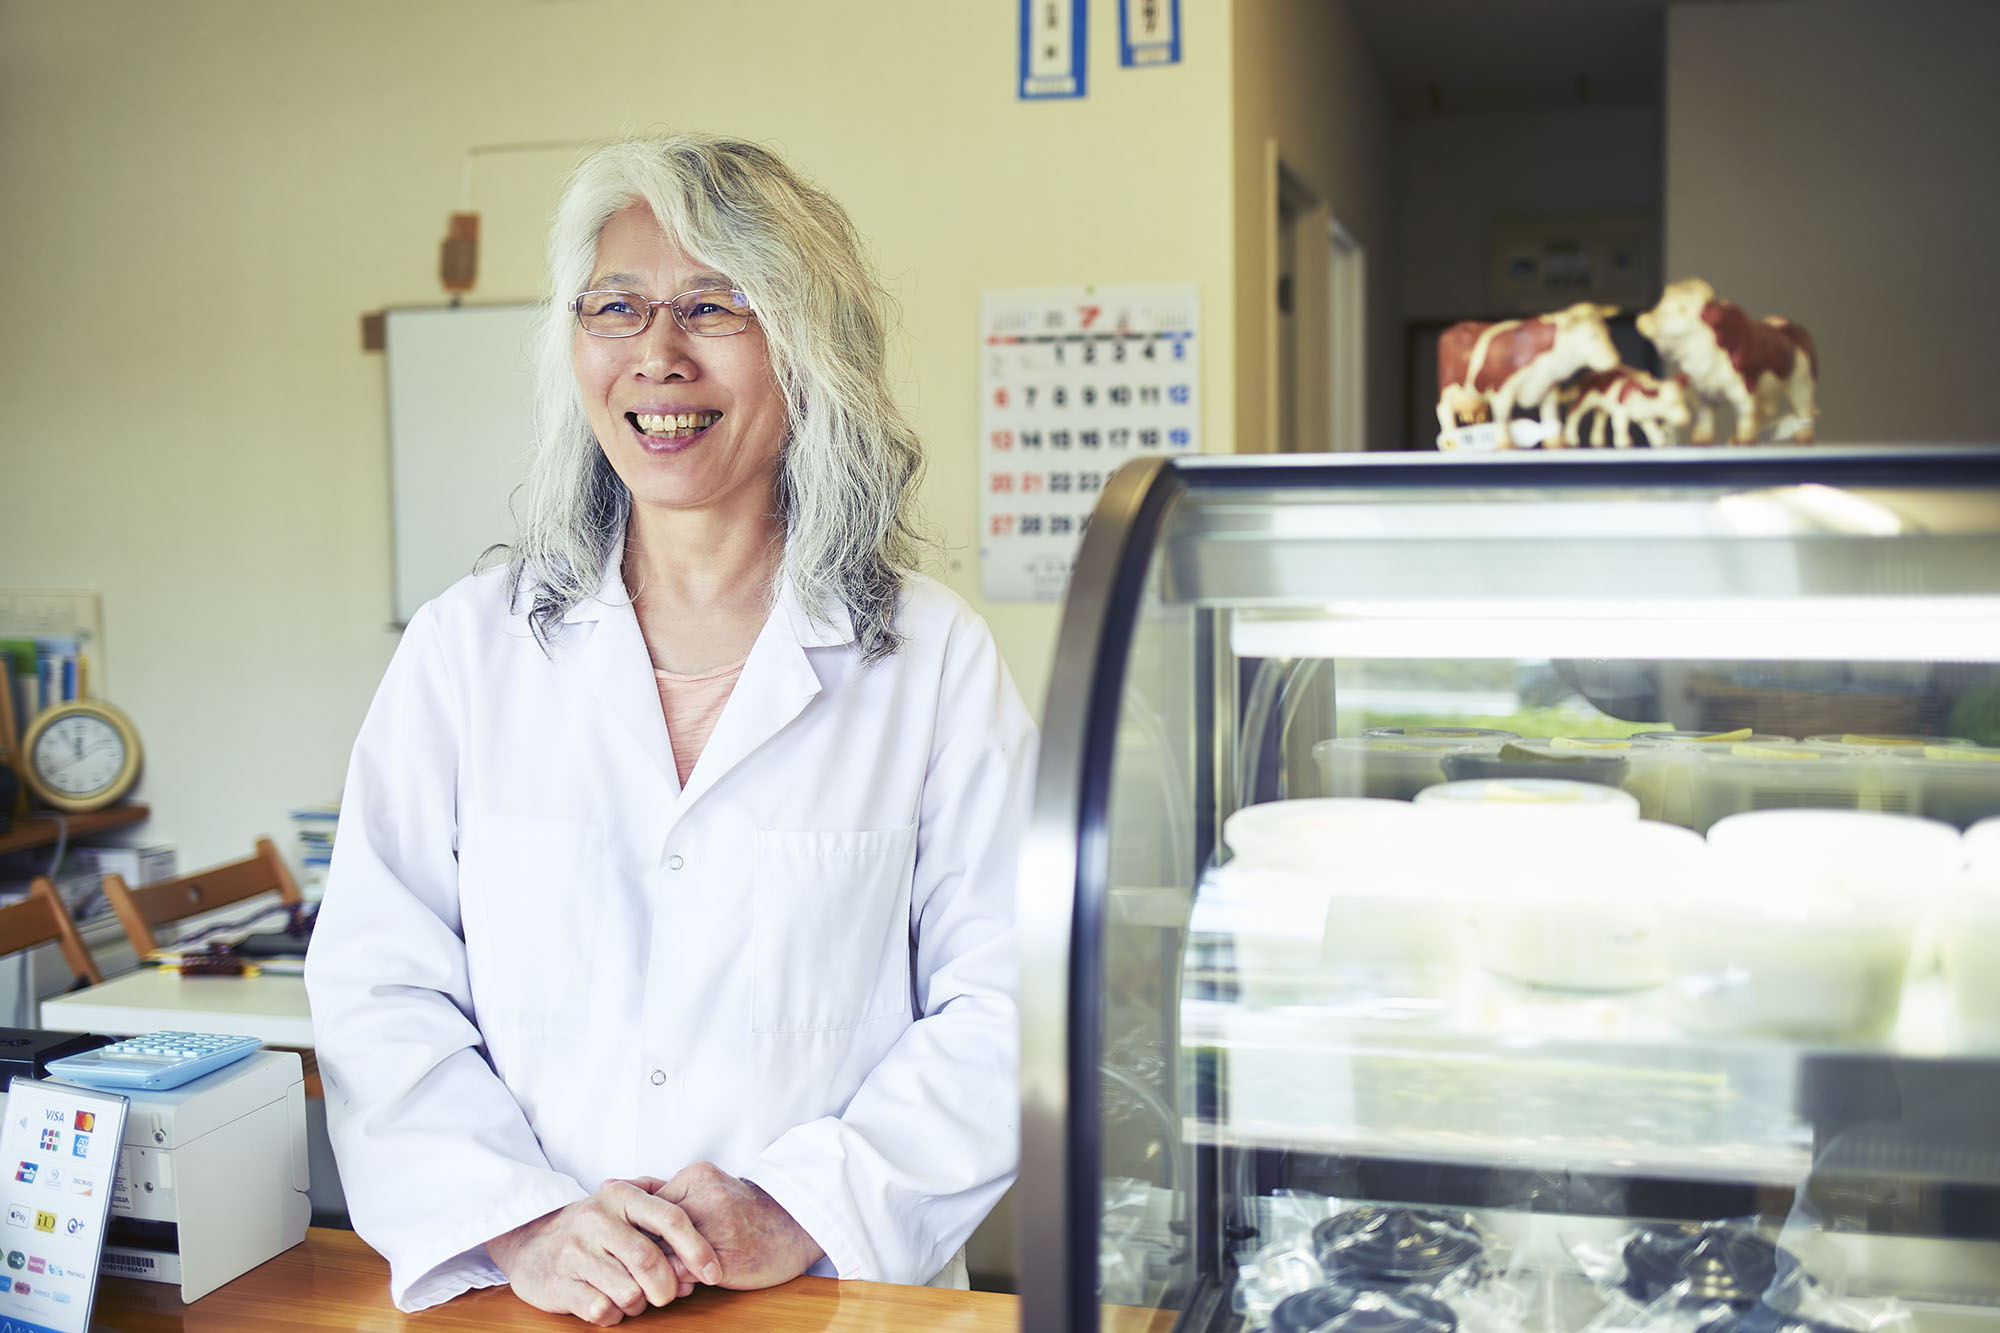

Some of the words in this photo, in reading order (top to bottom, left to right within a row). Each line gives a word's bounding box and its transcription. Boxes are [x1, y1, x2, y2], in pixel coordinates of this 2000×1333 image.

[1078, 305, 1102, 330] 7
[1054, 343, 1065, 364] 1
[1024, 387, 1038, 407] 7
[1108, 386, 1131, 406] 10
[1139, 386, 1160, 405] 11
[1020, 430, 1043, 449] 14
[1109, 428, 1131, 448] 17
[45, 1109, 64, 1122] VISA
[37, 1213, 56, 1230] iD
